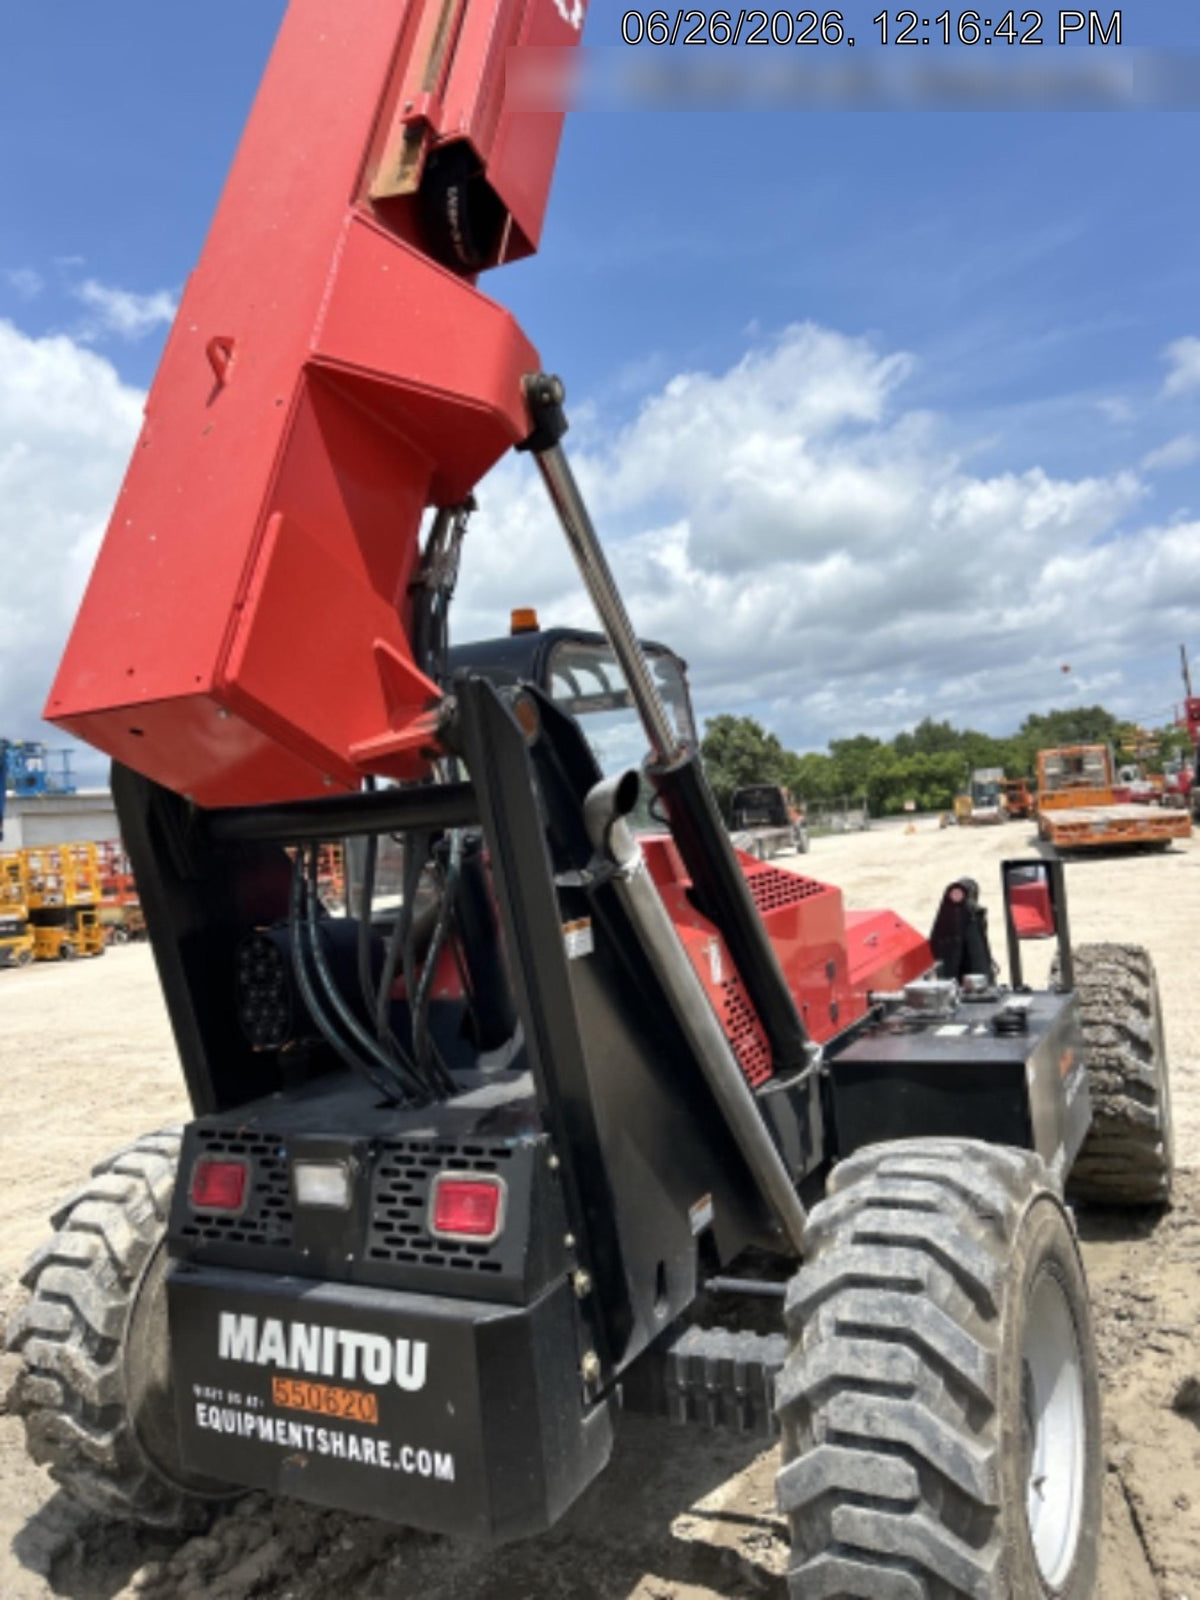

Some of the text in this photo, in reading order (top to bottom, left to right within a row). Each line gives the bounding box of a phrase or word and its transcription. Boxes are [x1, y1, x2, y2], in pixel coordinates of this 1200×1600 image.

[218, 1311, 428, 1391] MANITOU
[273, 1378, 374, 1421] 550620
[195, 1402, 455, 1482] EQUIPMENTSHARE.COM
